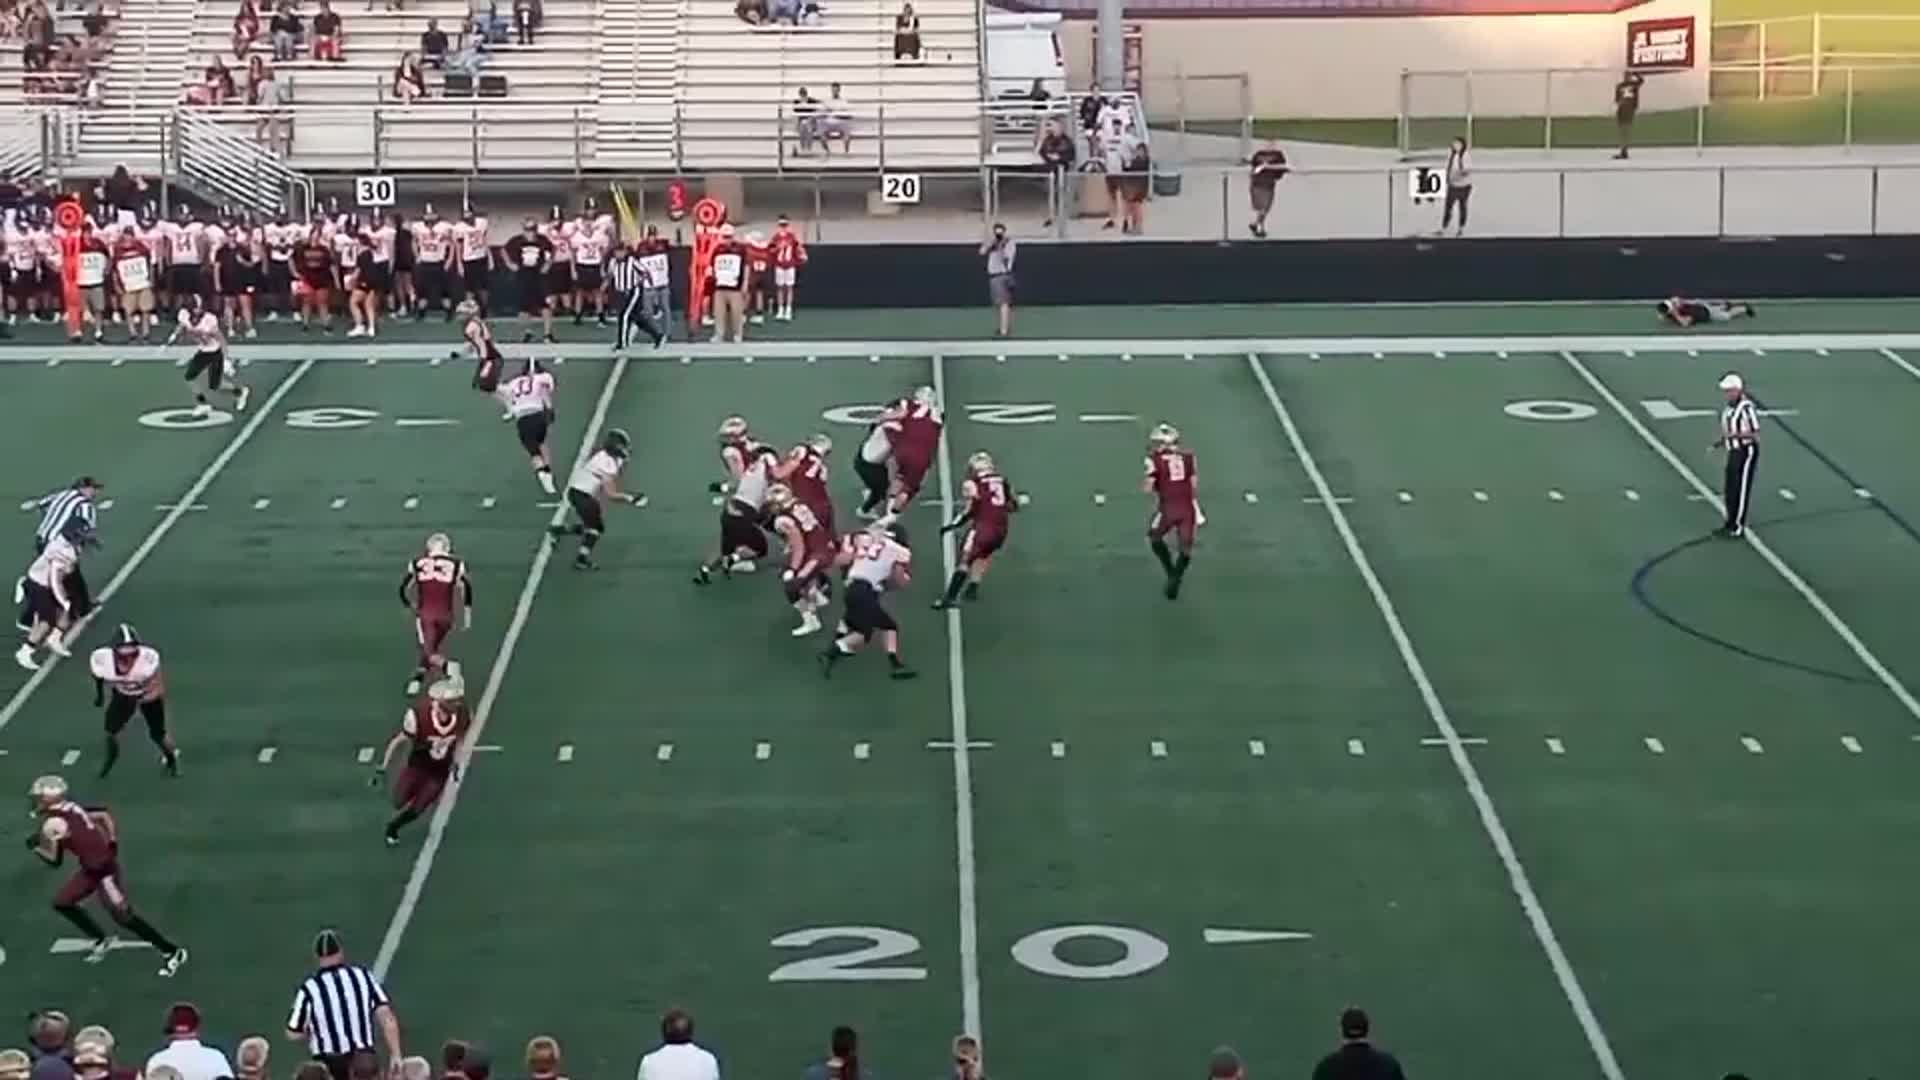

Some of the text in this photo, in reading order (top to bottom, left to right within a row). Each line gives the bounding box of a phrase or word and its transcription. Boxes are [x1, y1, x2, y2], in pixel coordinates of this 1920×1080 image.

[360, 179, 391, 203] 30
[887, 178, 916, 198] 20
[768, 924, 1169, 982] 20
